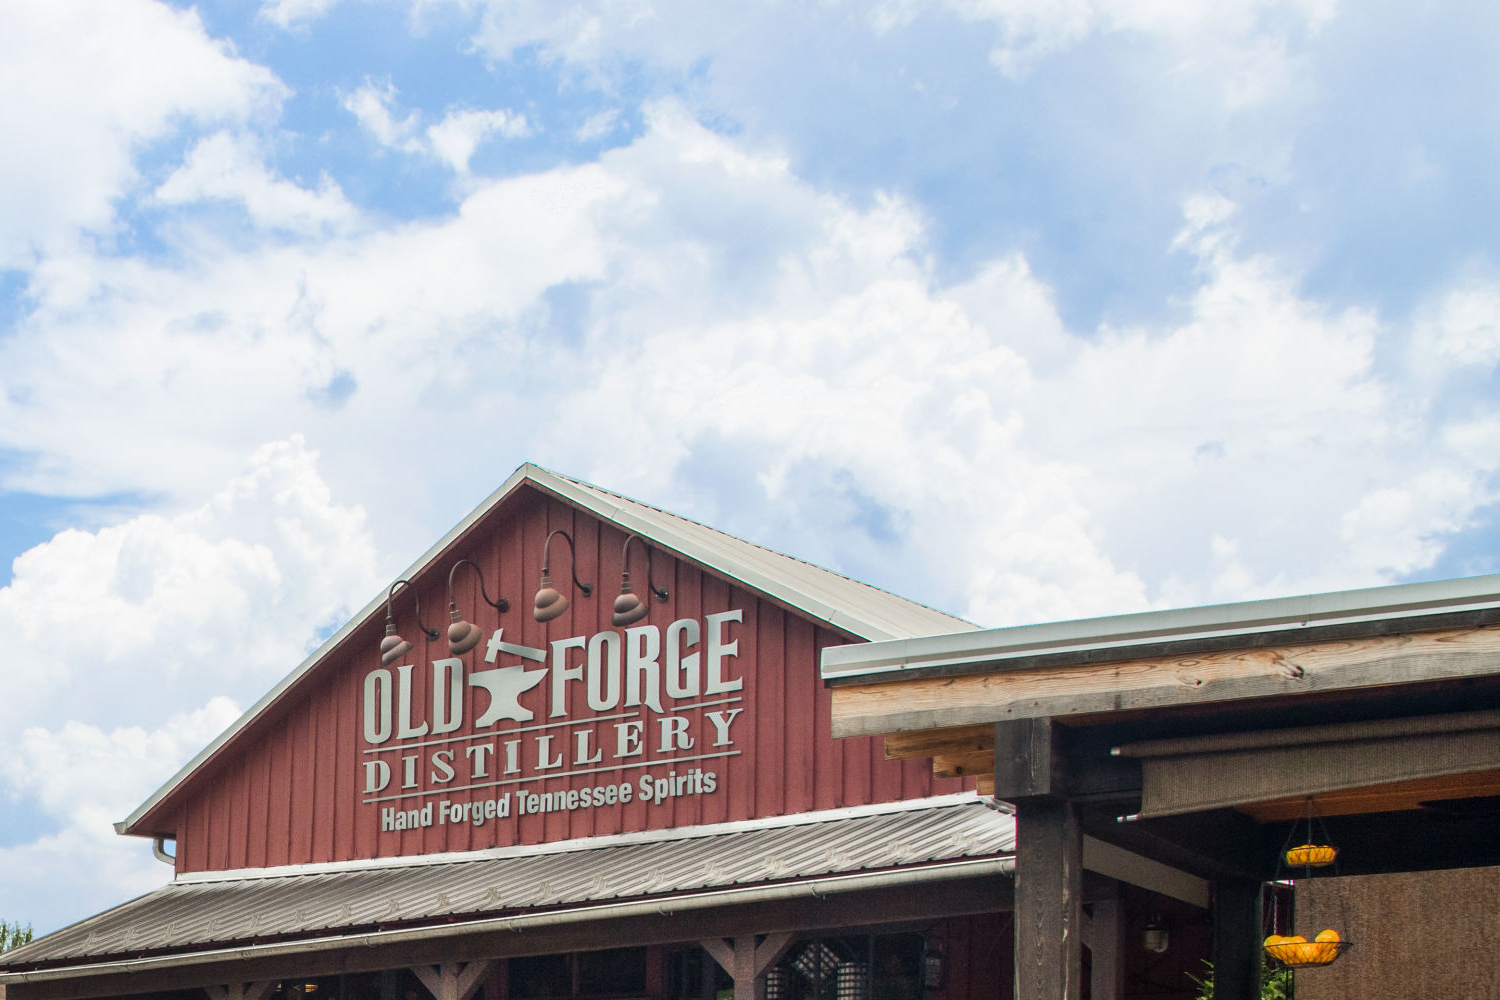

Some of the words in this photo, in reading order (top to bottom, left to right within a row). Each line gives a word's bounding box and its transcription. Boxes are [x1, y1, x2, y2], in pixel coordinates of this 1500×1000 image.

[363, 657, 464, 745] OLD
[549, 608, 744, 719] FORGE
[362, 708, 744, 794] DISTILLERY
[381, 802, 434, 833] Hand
[438, 792, 511, 827] Forged
[515, 782, 632, 815] Tennessee
[638, 767, 718, 805] Spirits
